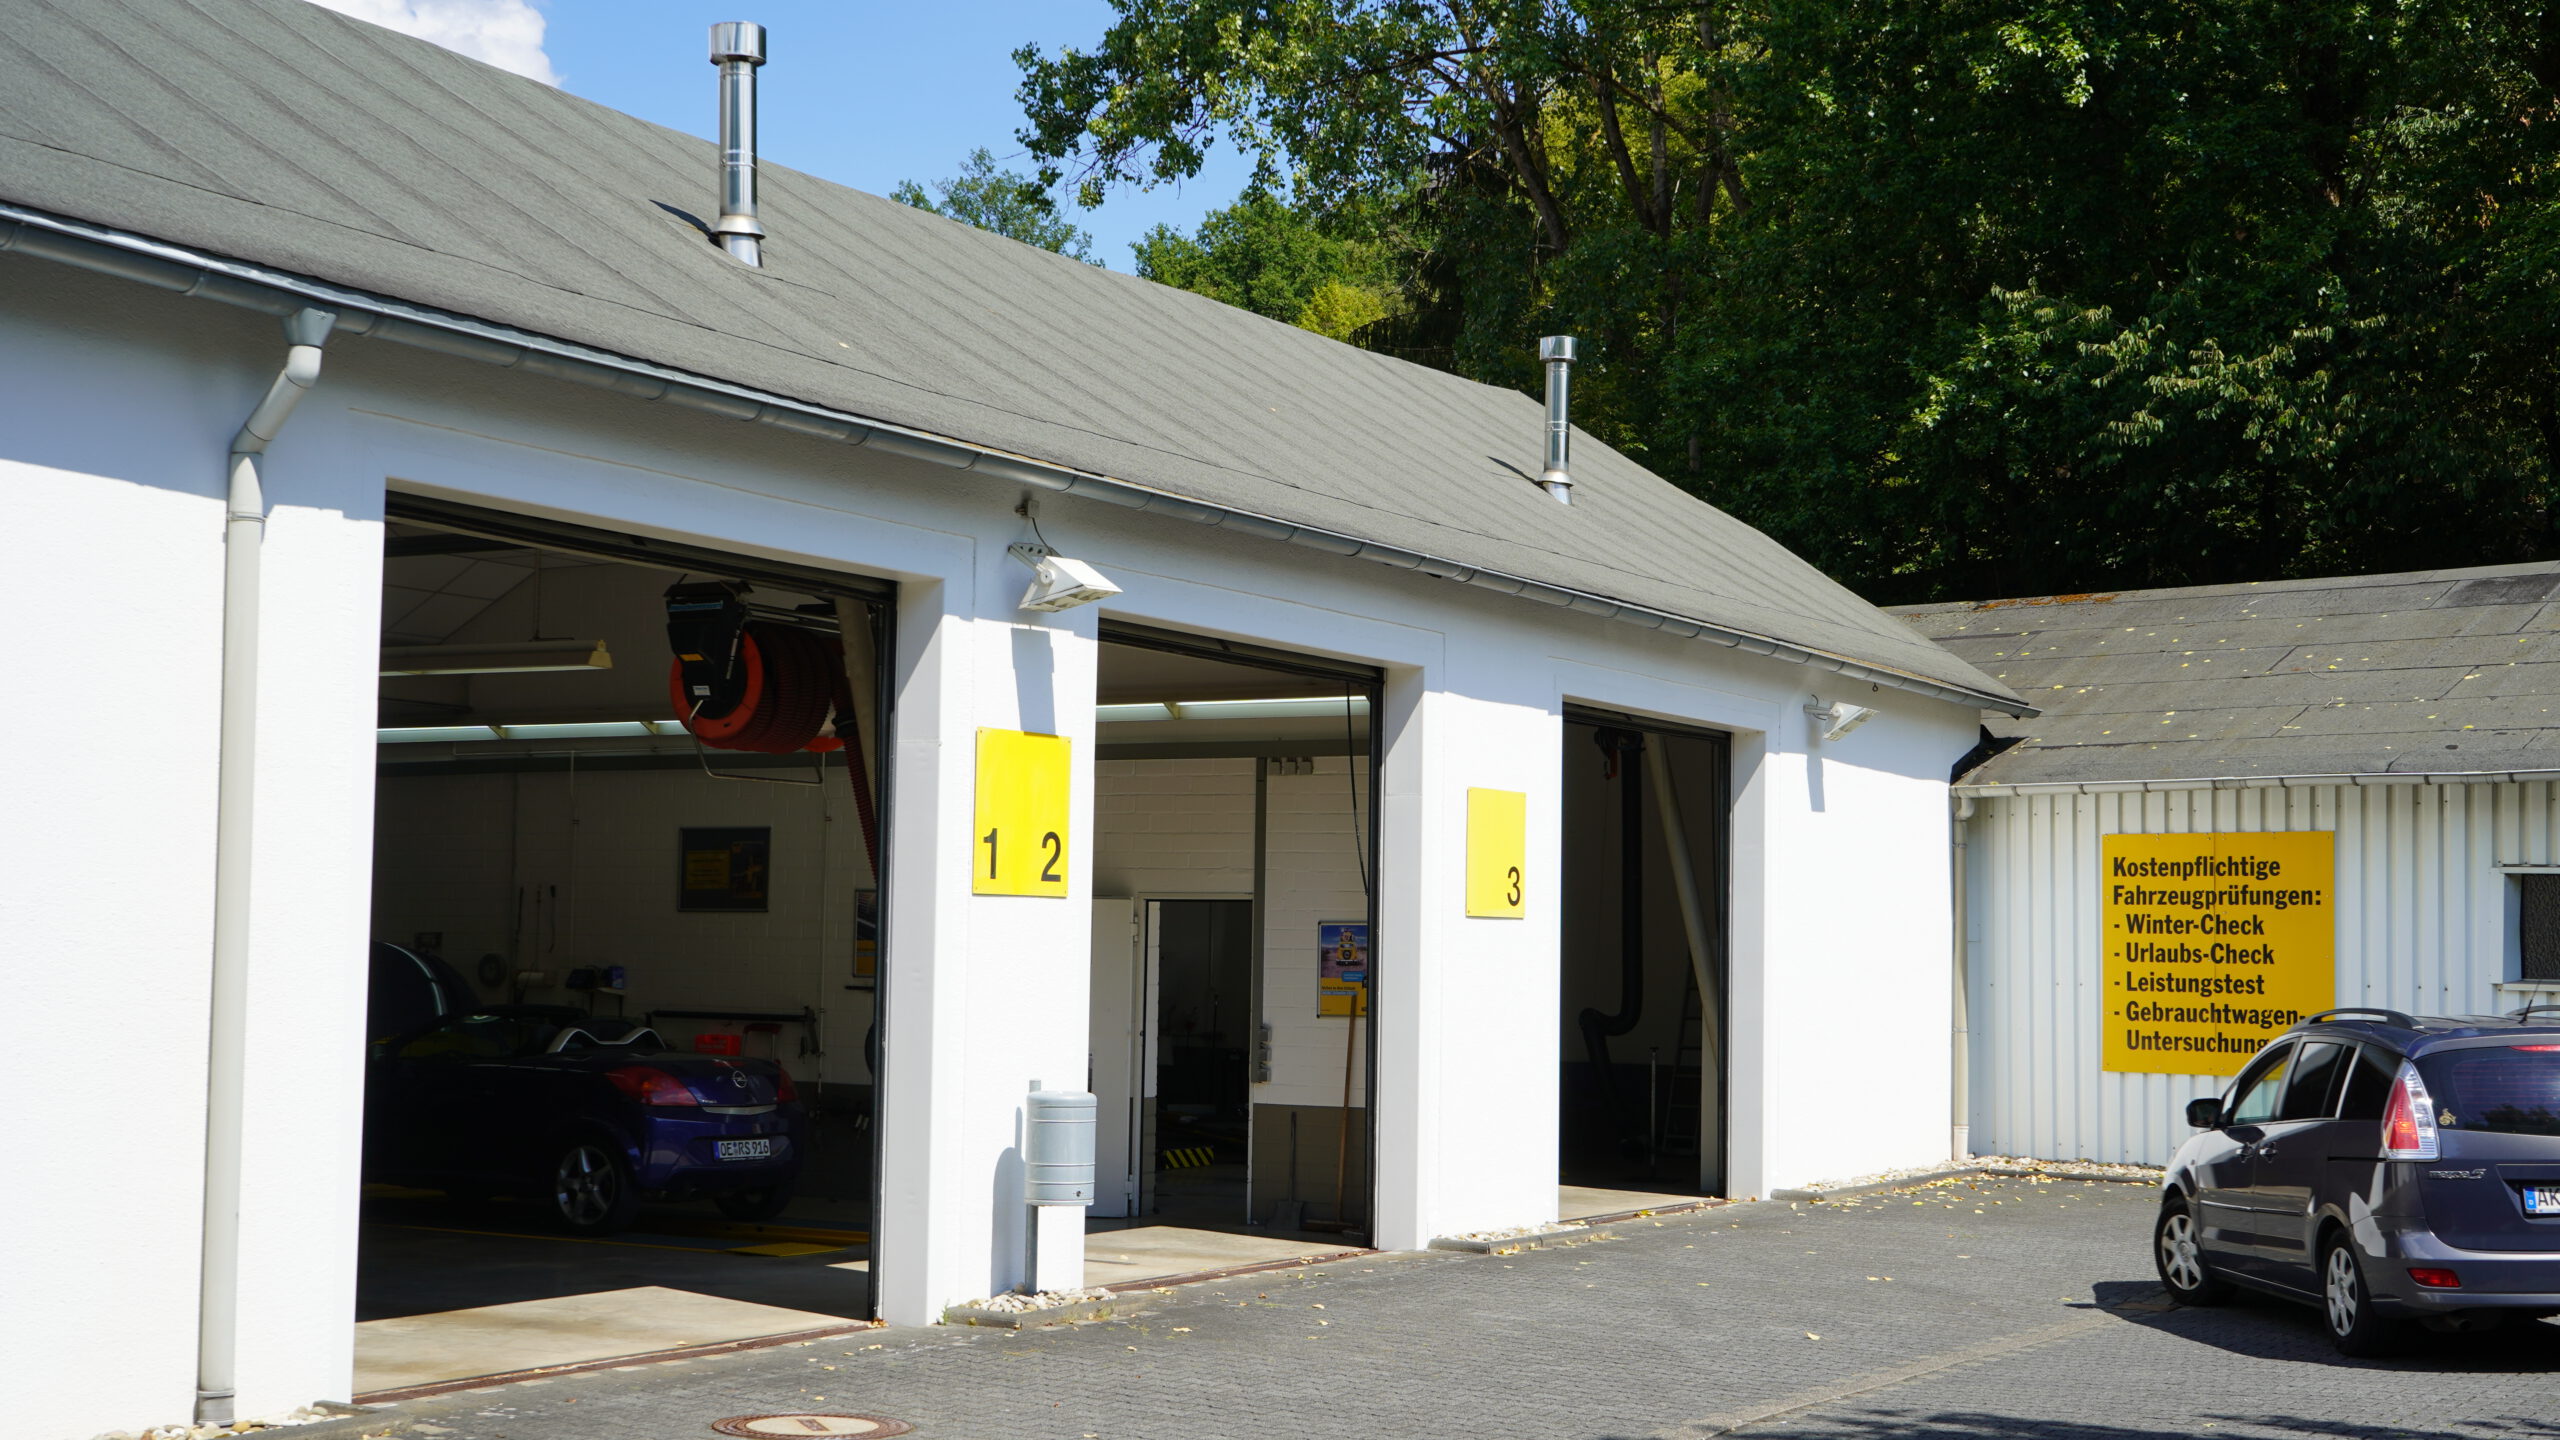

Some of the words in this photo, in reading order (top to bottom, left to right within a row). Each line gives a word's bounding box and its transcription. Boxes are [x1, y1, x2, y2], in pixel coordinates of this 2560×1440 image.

[983, 828, 998, 879] 1
[1041, 831, 1061, 882] 2
[2113, 855, 2281, 881] Kostenpflichtige
[1507, 866, 1521, 907] 3
[2113, 885, 2322, 910] Fahrzeugprüfungen:
[2126, 913, 2265, 936] Winter-Check
[2126, 942, 2275, 965] Urlaubs-Check
[2126, 971, 2265, 998] Leistungstest
[752, 1140, 769, 1155] 916
